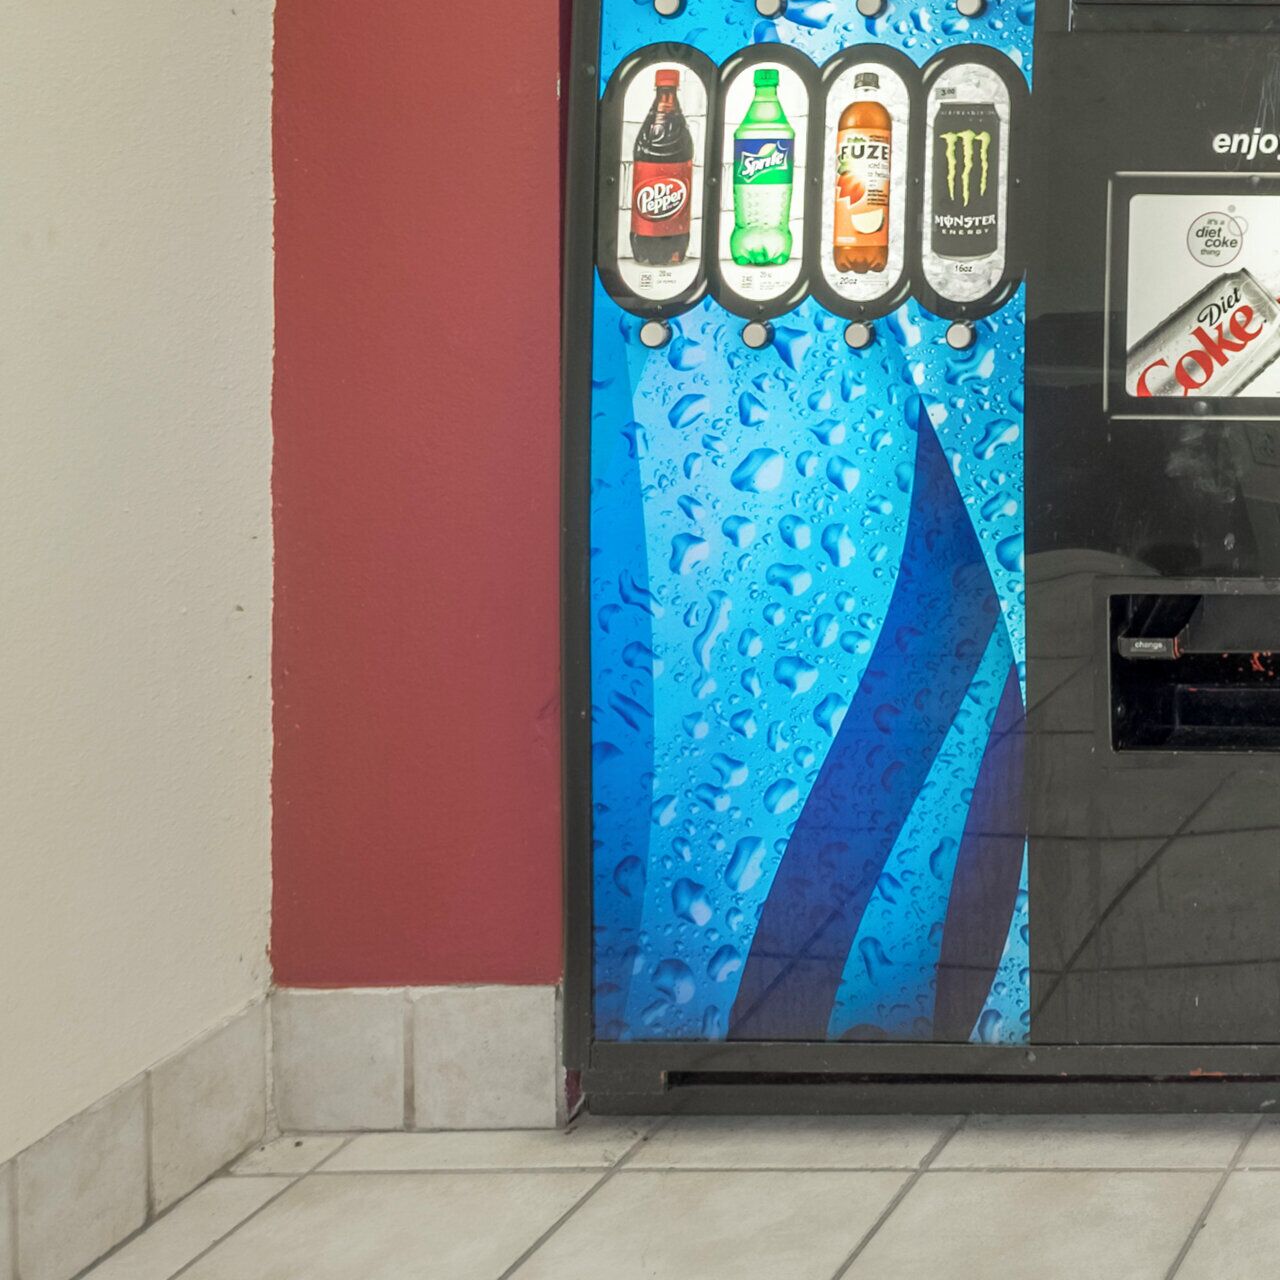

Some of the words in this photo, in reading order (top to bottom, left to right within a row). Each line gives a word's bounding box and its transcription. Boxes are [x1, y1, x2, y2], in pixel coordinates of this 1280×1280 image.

[841, 144, 889, 161] FUZE
[741, 151, 785, 177] Sprite
[655, 182, 674, 200] Dr
[641, 185, 685, 214] Pepper
[934, 214, 996, 229] MONSTER
[1195, 225, 1222, 239] diet
[1204, 236, 1238, 248] coke
[1200, 247, 1221, 257] thing
[955, 263, 973, 272] 16oz
[1197, 287, 1242, 327] Diet
[1136, 304, 1265, 397] Coke
[1134, 640, 1163, 650] change
